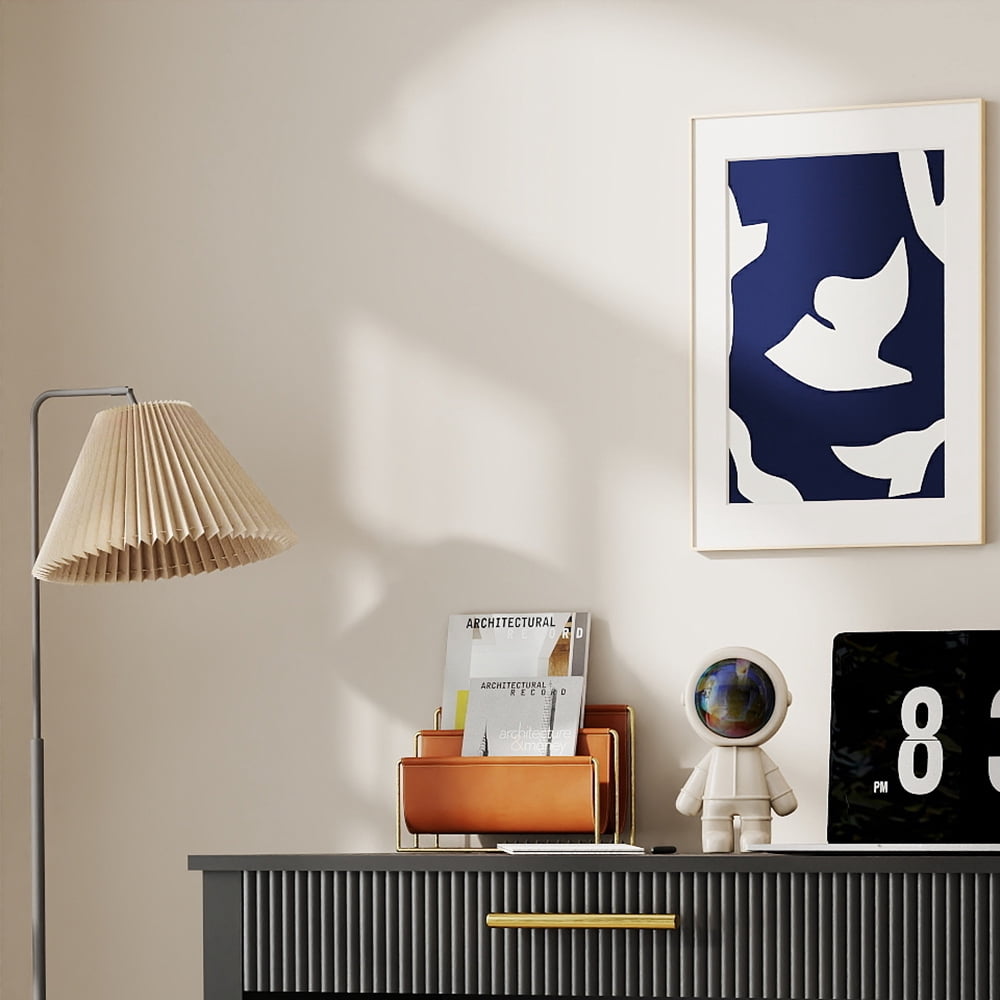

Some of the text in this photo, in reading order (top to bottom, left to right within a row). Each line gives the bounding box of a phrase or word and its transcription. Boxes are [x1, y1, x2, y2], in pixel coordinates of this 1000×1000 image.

[466, 616, 556, 629] ARCHITECTURAL
[481, 681, 547, 689] ARCHITECTURAL
[510, 688, 567, 696] RECORD
[873, 781, 888, 793] PM
[898, 686, 943, 795] 8
